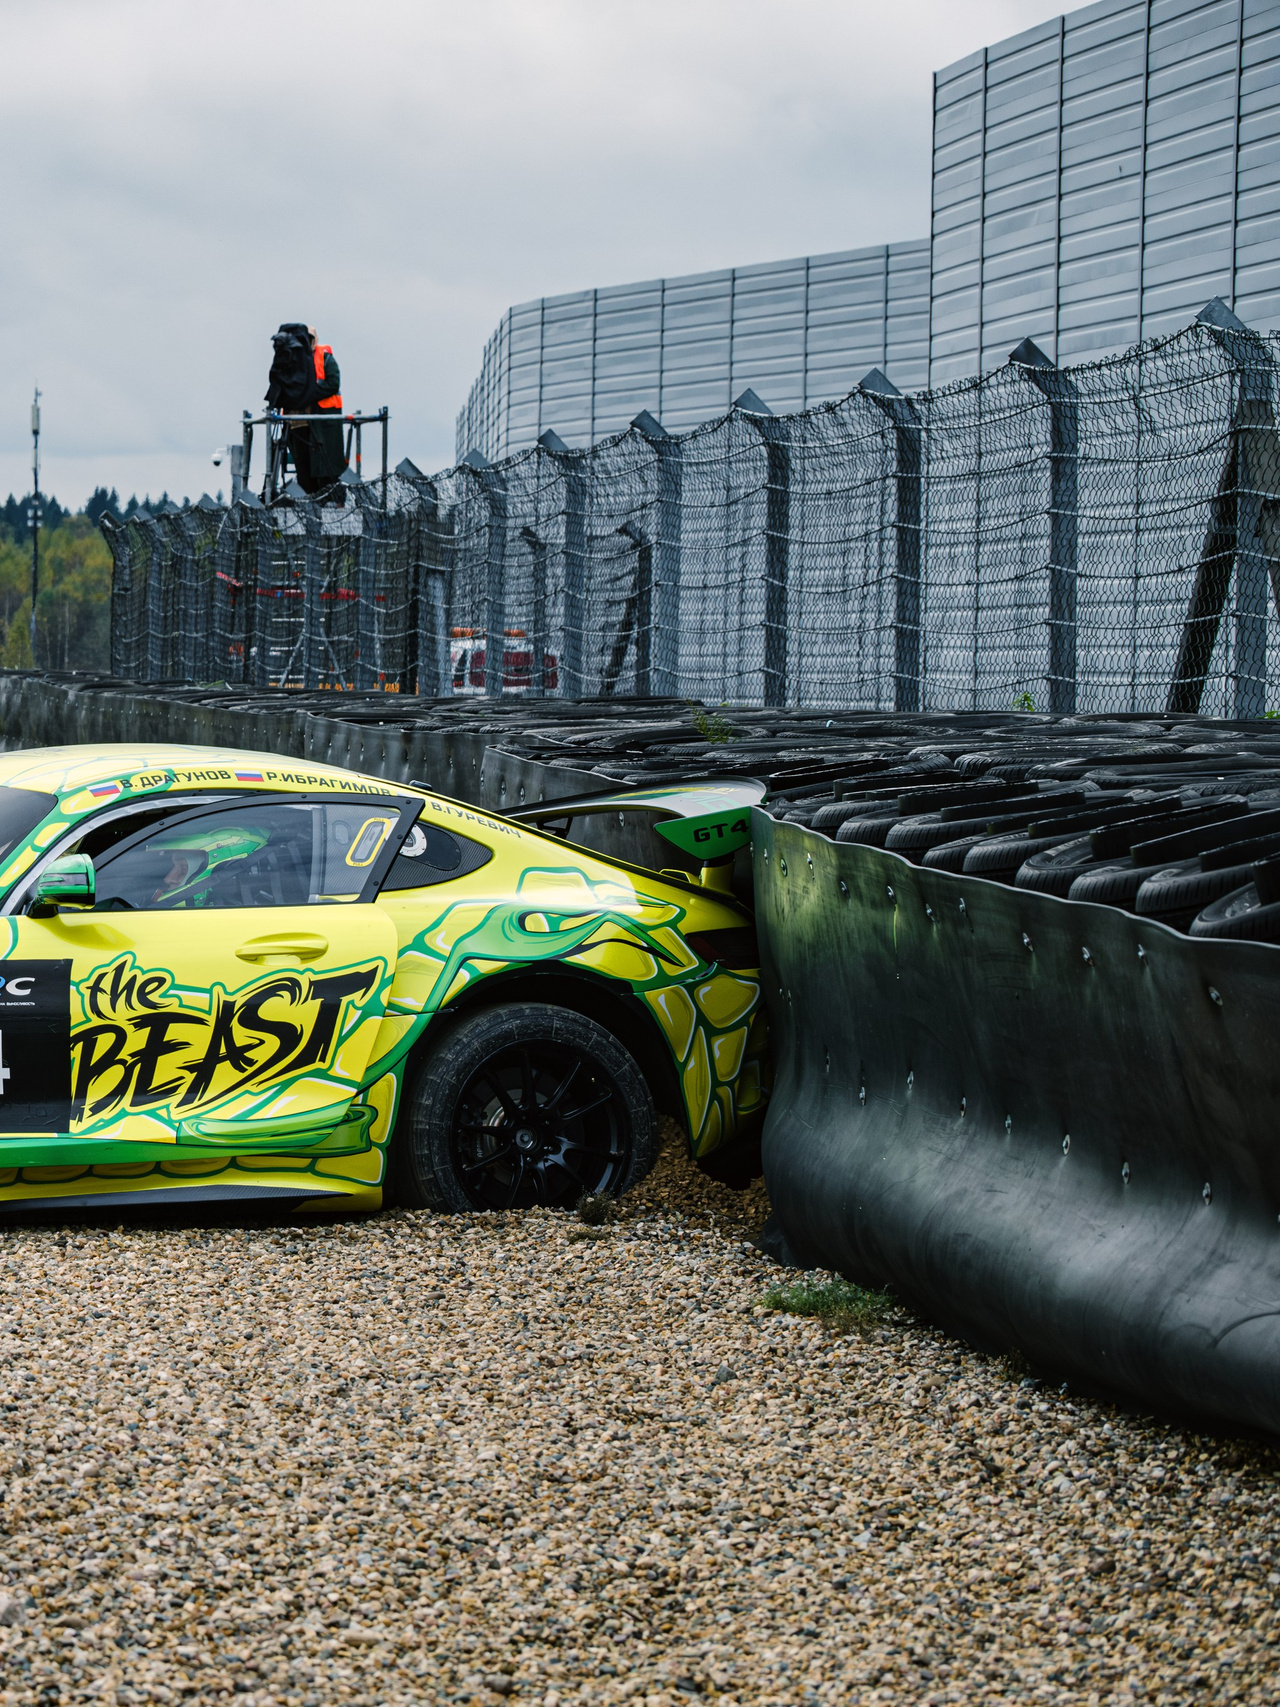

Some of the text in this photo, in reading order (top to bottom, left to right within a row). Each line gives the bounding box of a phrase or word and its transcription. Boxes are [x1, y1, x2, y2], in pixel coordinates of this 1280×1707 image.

[140, 770, 232, 788] ДРАГУНОВ
[693, 818, 749, 843] GT4
[89, 959, 167, 1021] the
[71, 965, 380, 1122] BEAST
